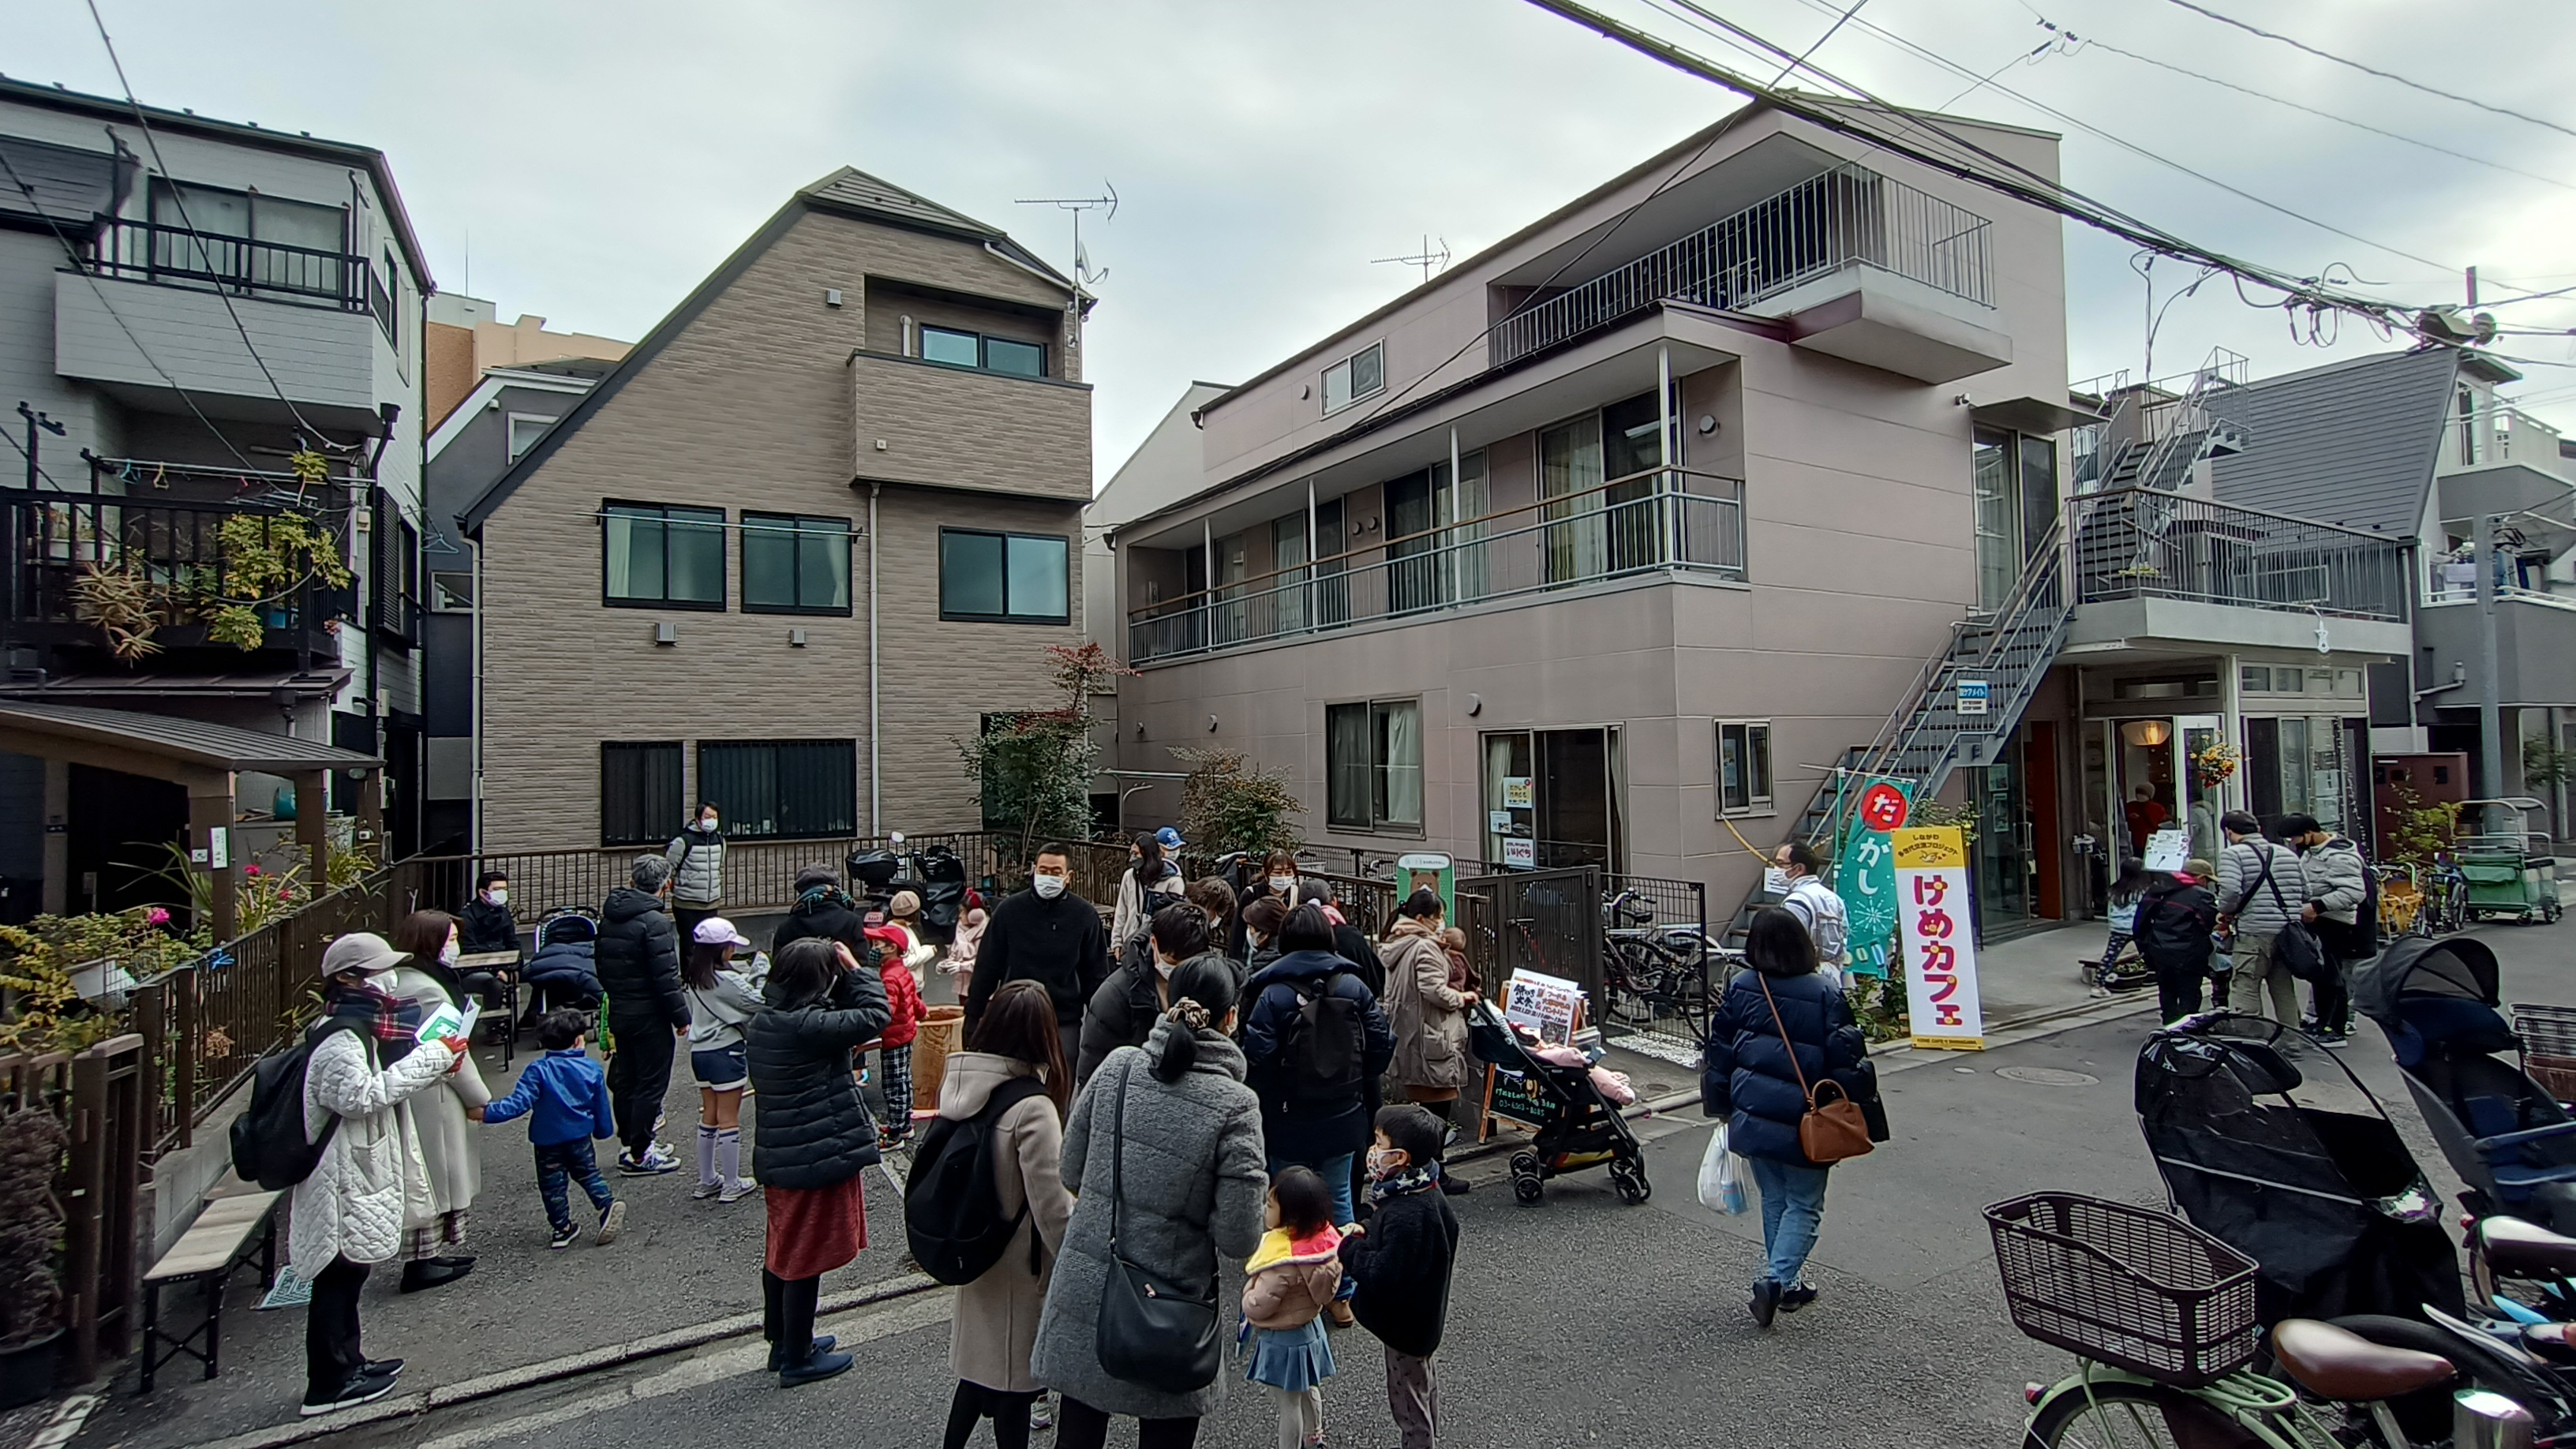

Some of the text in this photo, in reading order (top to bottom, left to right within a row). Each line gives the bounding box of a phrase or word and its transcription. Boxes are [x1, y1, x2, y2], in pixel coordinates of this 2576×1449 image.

[1913, 874, 1964, 1026] けめカフェ
